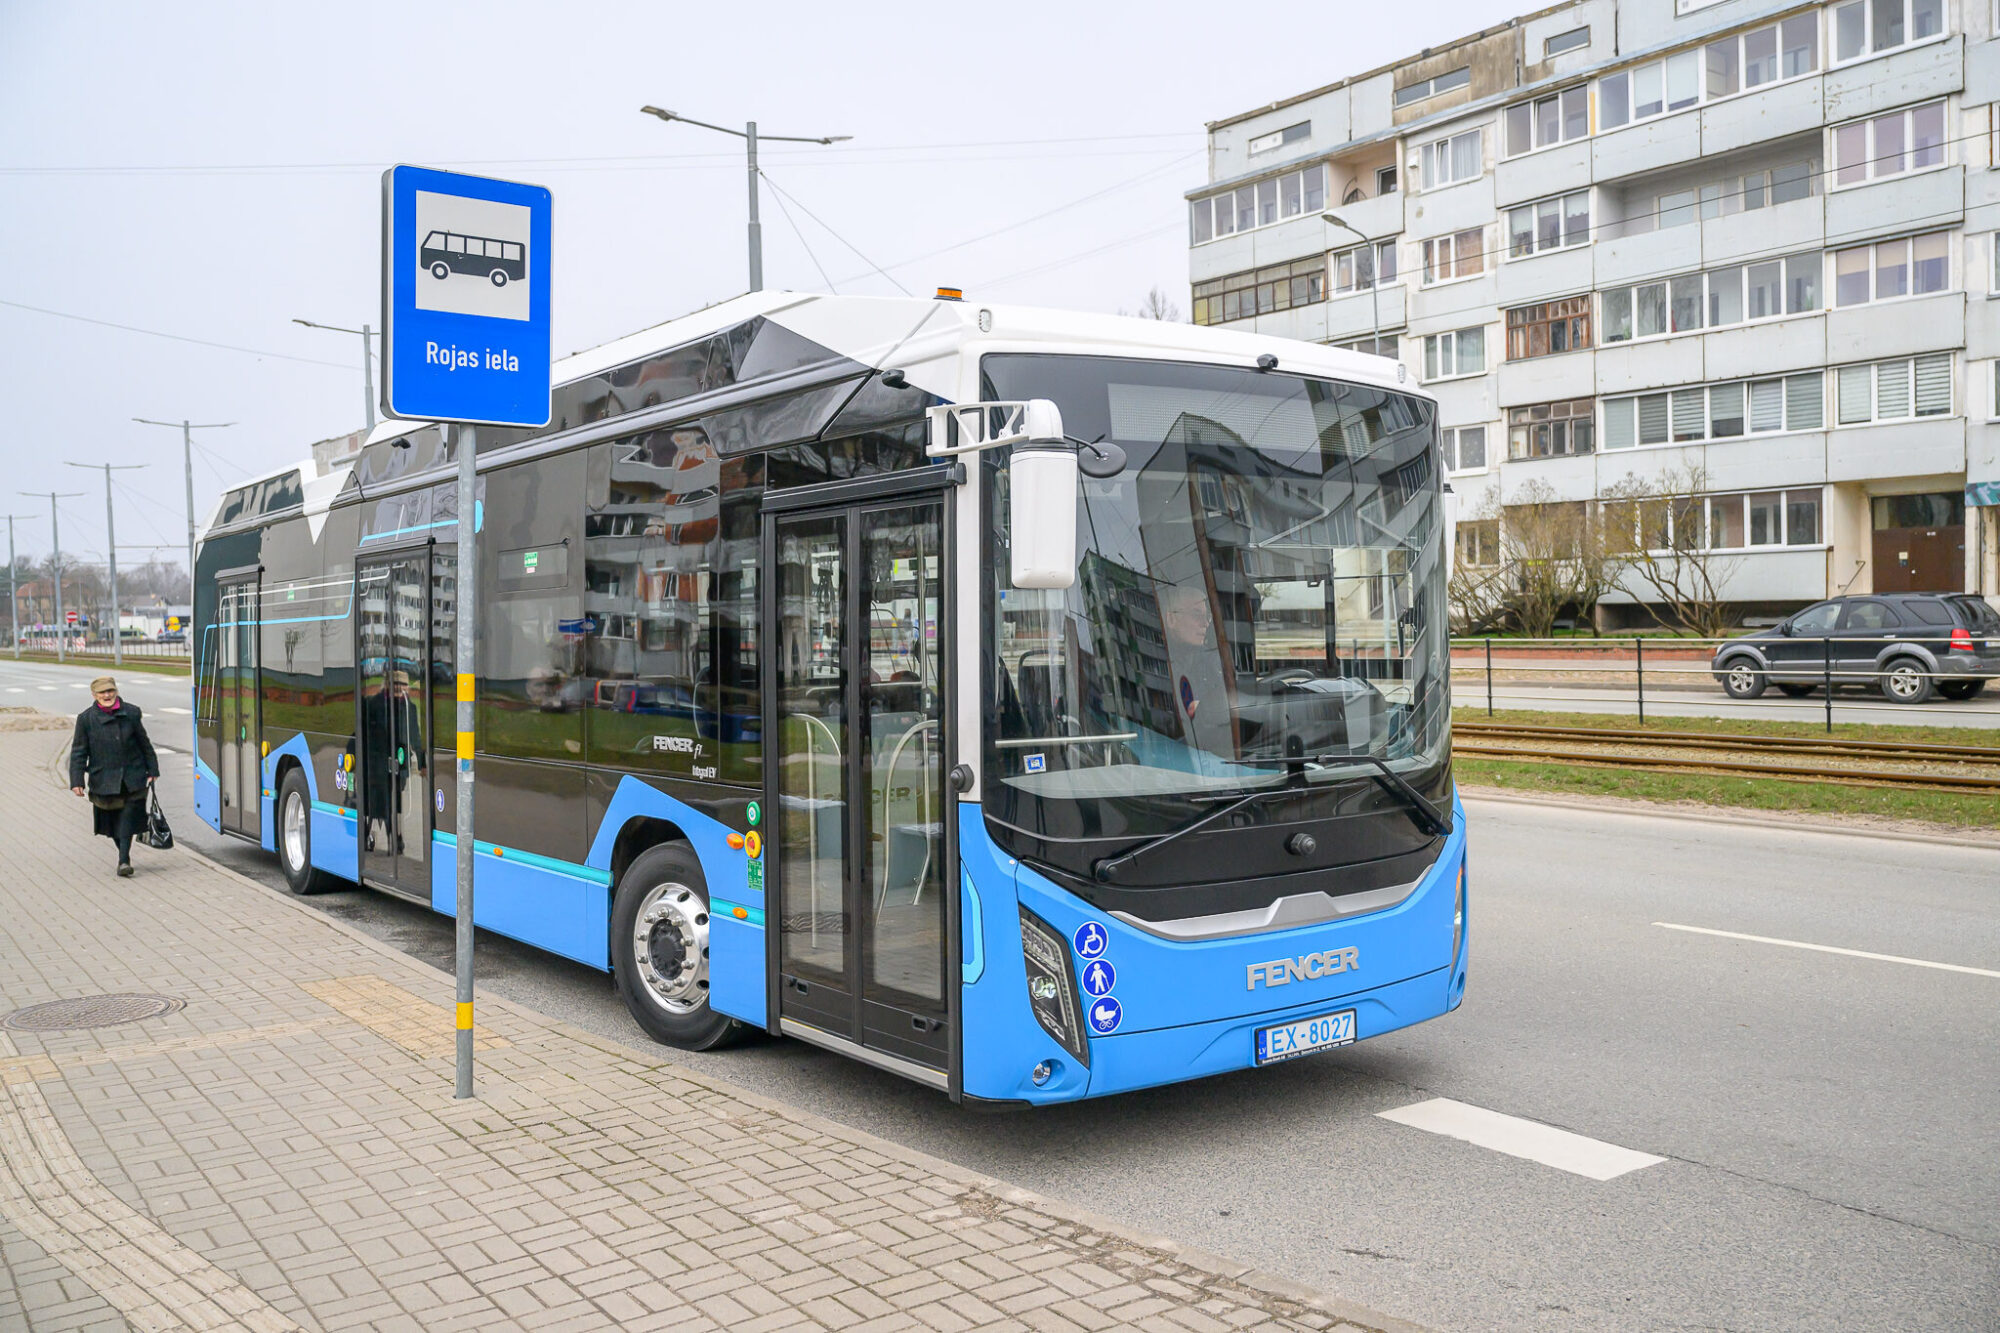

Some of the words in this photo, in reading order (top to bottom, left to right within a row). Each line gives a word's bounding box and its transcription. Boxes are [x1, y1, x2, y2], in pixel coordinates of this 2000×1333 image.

[426, 341, 479, 372] Rojas
[485, 348, 519, 372] iela
[653, 735, 694, 753] FENCER
[1246, 945, 1360, 991] FENCER
[1271, 1014, 1352, 1054] EX-8027
